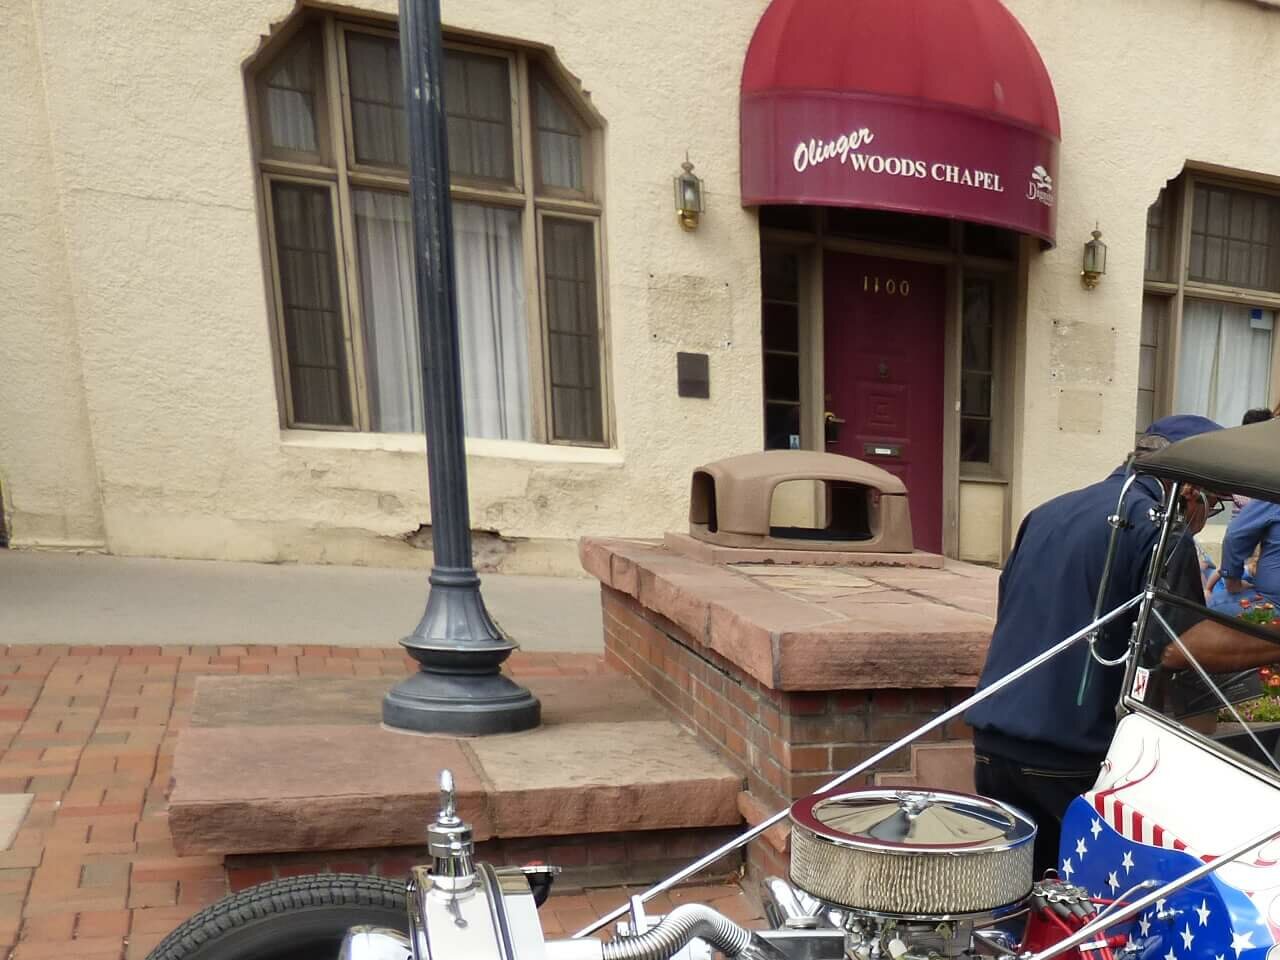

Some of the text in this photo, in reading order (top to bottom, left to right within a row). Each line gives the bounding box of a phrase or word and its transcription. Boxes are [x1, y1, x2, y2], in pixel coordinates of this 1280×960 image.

[793, 128, 874, 173] Olinger
[850, 153, 1004, 193] WOODS CHAPEL
[863, 275, 910, 296] 1100
